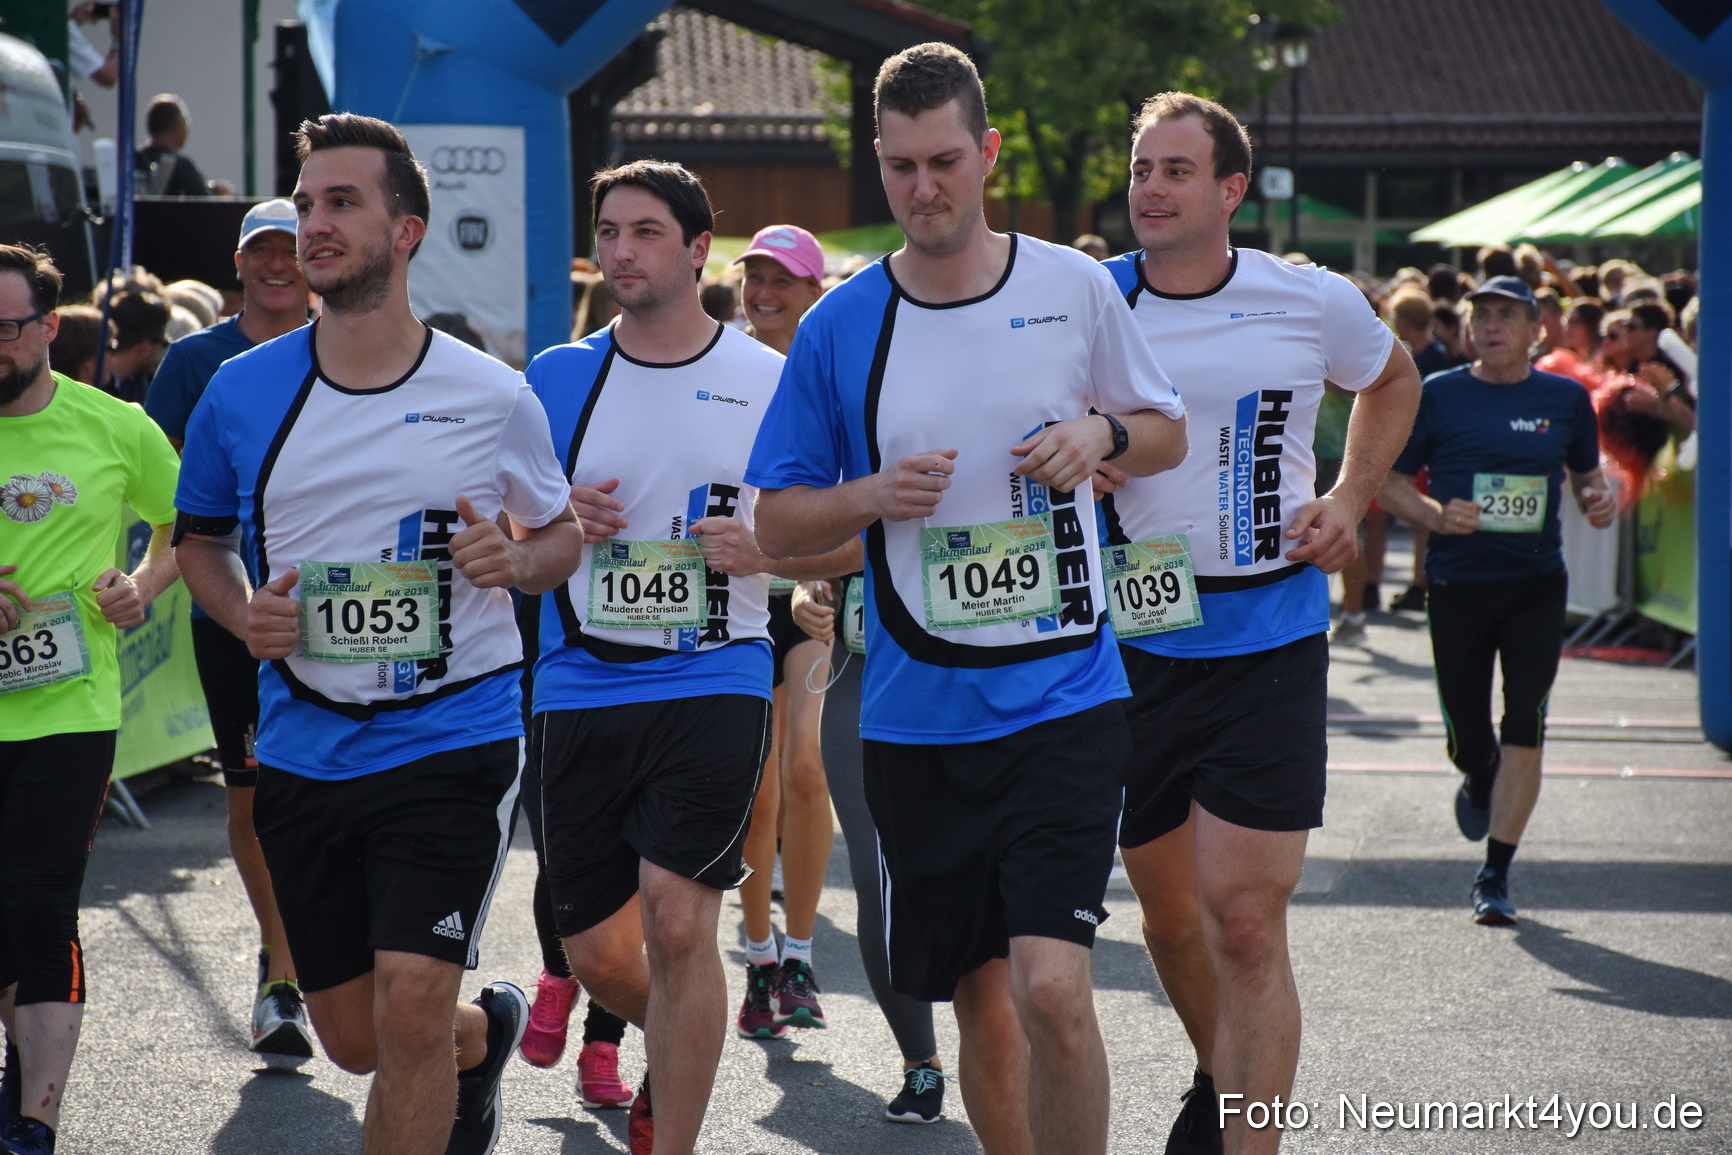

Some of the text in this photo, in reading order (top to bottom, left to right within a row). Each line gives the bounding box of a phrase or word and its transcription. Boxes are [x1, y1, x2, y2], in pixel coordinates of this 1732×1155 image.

[1510, 418, 1536, 431] vhs
[1252, 389, 1294, 564] HUBER
[1219, 426, 1231, 560] WASTE WATER Solutions
[1236, 425, 1252, 558] TECHNOLOGY
[1481, 495, 1538, 516] 2399
[940, 543, 993, 558] firmenlauf
[1023, 540, 1046, 553] 2019
[675, 562, 697, 571] 2019
[1164, 560, 1184, 570] 2019
[939, 554, 1040, 601] 1049
[319, 581, 373, 592] firmenlauf
[404, 587, 429, 596] 2019
[601, 571, 689, 604] 1048
[1113, 571, 1181, 612] 1039
[602, 604, 688, 614] Mauderer Christian
[961, 595, 1025, 611] Meier Martin
[317, 598, 420, 634] 1053
[975, 606, 1013, 617] HUBER SE
[1131, 607, 1167, 620] Dürr Josef
[50, 614, 71, 627] 2019
[1138, 618, 1156, 627] HUBER
[330, 635, 408, 645] Schießl Robert
[23, 660, 62, 675] Miroslav
[1074, 909, 1098, 926] adidas
[432, 925, 465, 941] adidas
